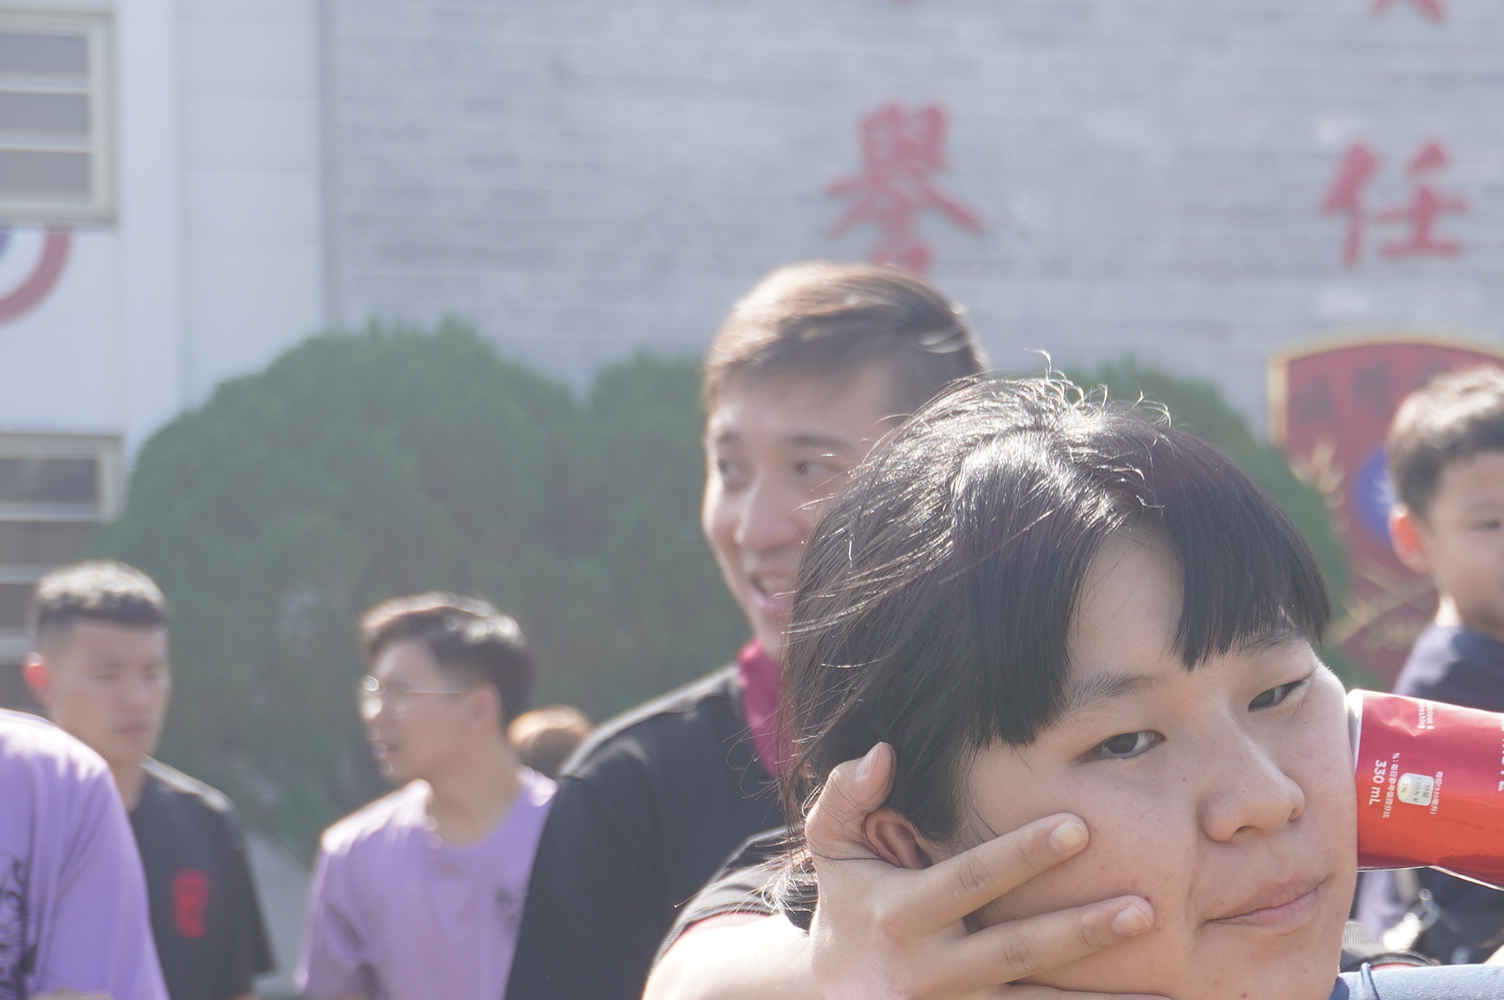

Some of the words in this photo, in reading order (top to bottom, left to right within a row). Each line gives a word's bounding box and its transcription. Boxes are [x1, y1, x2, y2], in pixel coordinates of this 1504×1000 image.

[1321, 143, 1469, 270] 任
[1372, 759, 1387, 784] 330
[1368, 786, 1382, 806] mL
